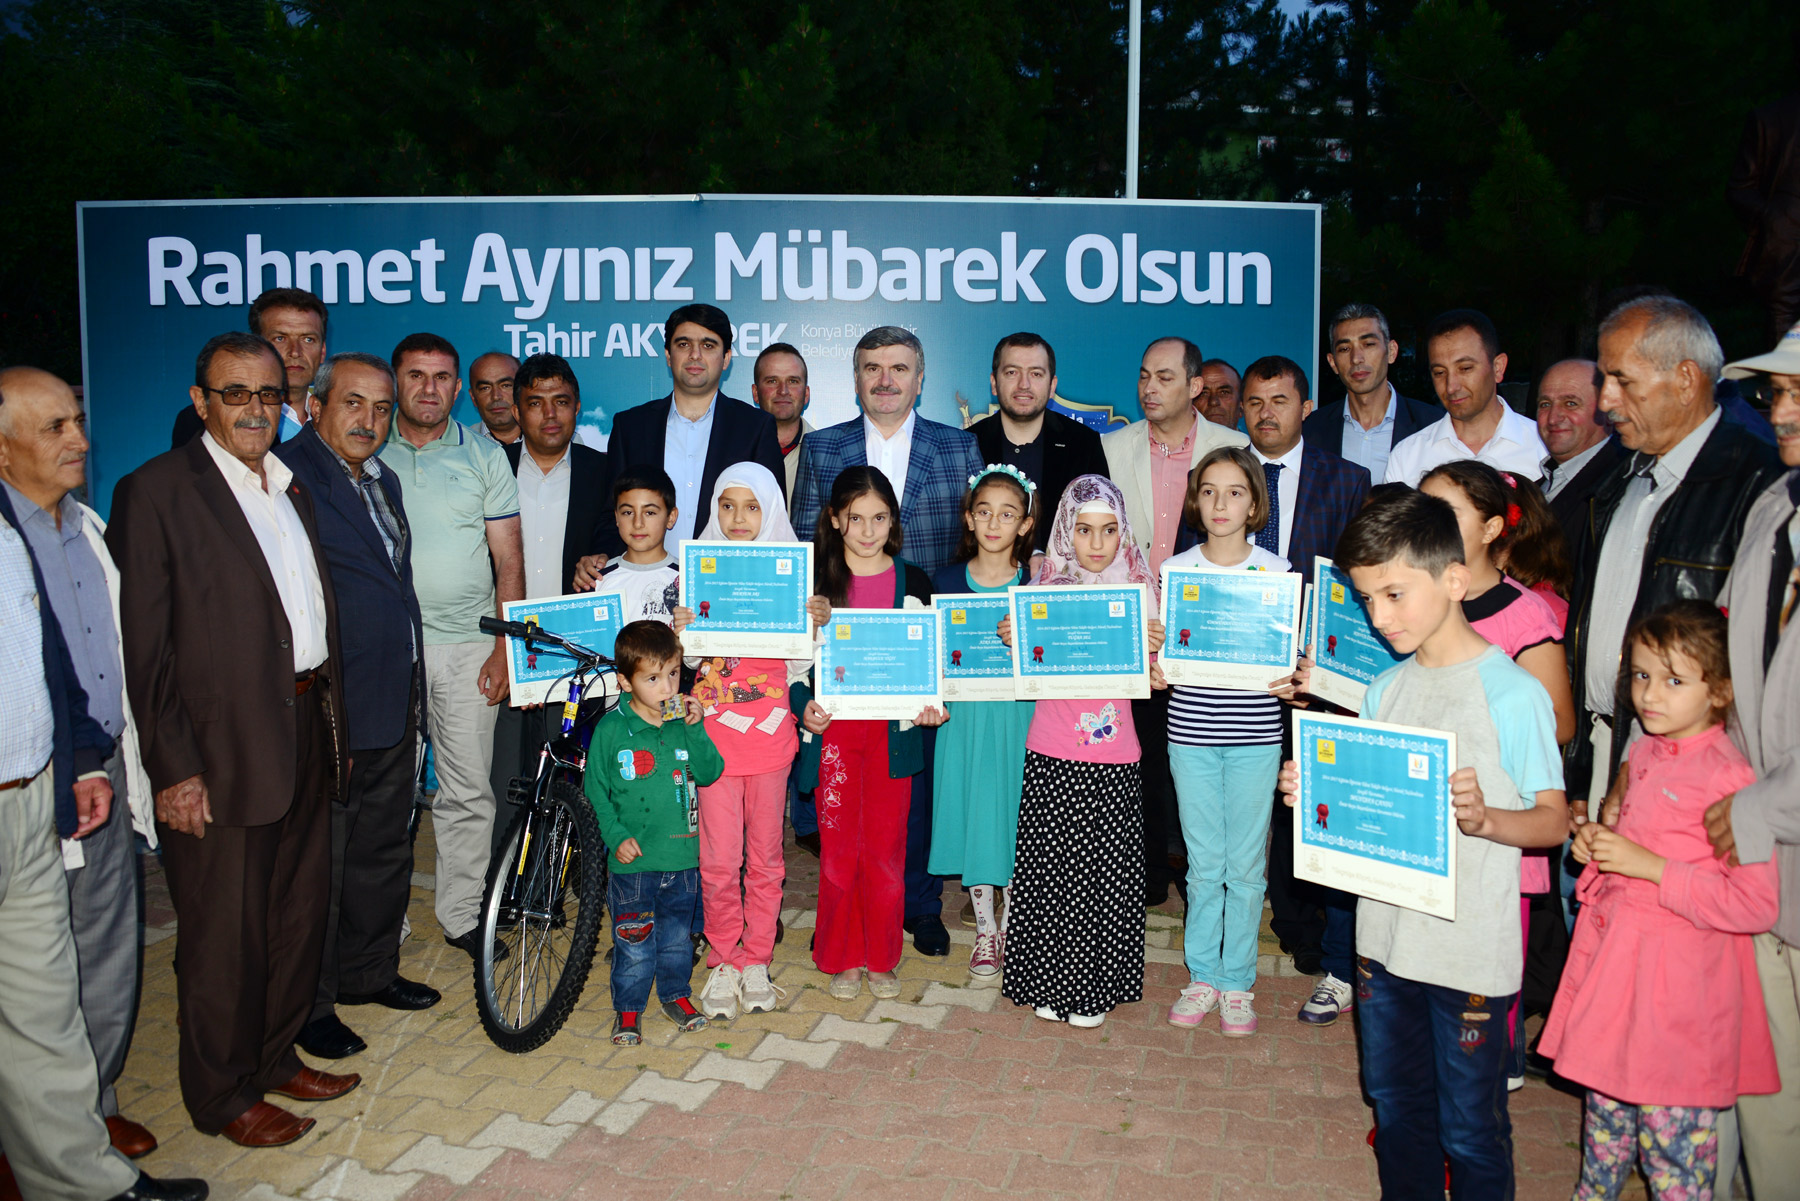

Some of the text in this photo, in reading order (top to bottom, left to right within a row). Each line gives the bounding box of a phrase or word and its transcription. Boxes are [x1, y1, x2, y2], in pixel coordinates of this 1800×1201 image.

[148, 230, 1272, 320] Rahmet Ayınız Mübarek Olsun
[504, 322, 597, 358] Tahir
[801, 323, 842, 341] Konya
[801, 343, 854, 361] Belediye
